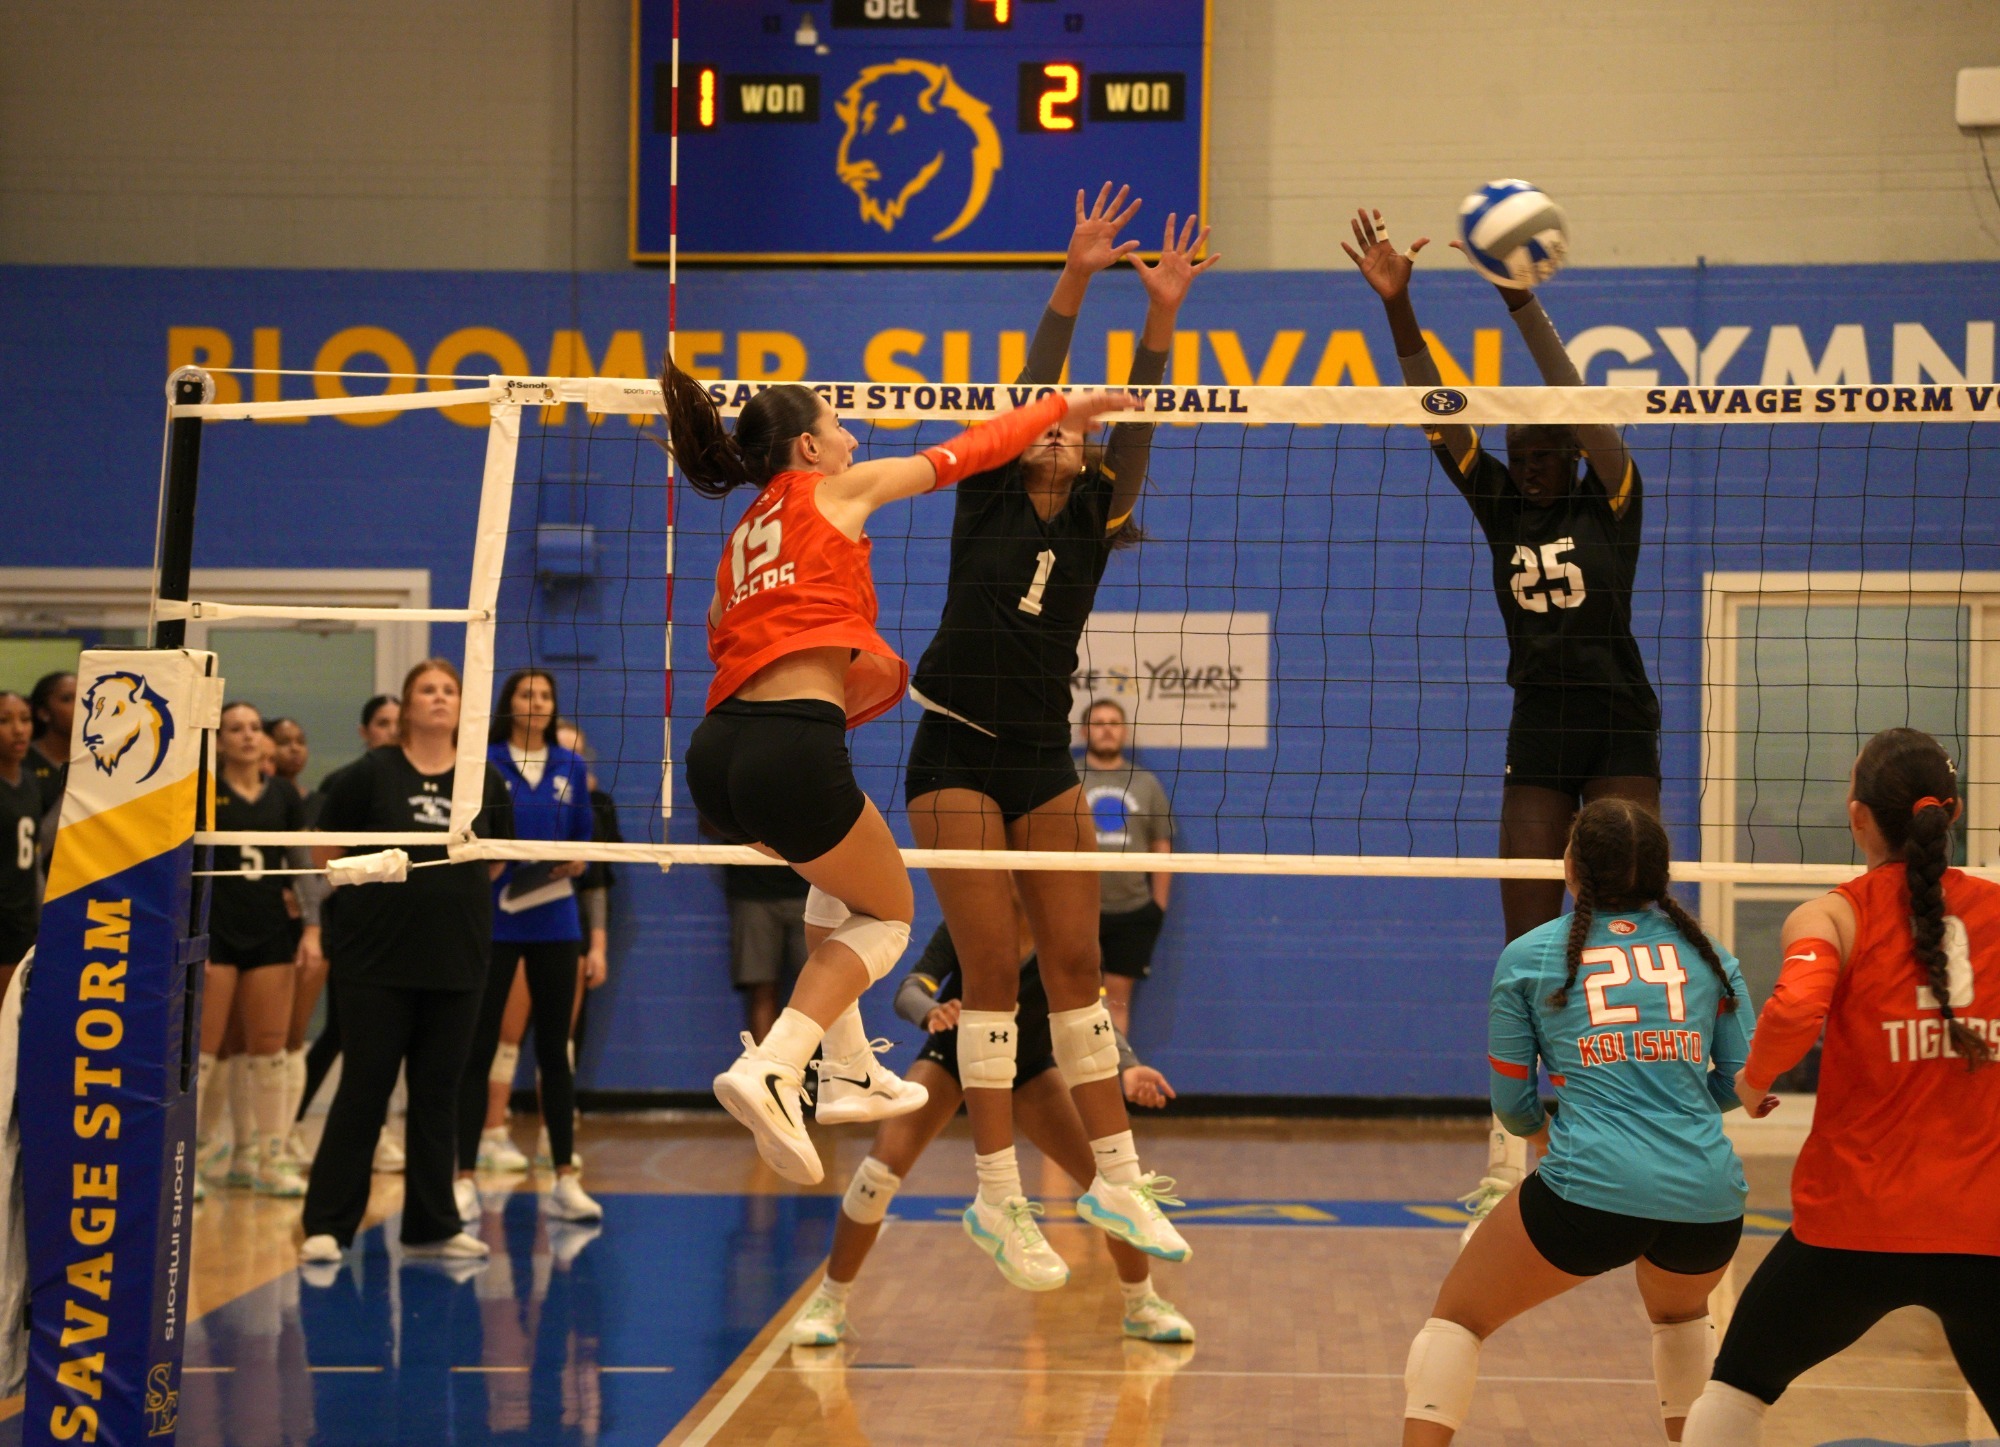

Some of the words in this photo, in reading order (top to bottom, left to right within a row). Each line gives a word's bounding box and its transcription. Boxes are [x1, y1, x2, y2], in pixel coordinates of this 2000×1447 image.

[698, 68, 715, 127] 1
[740, 82, 805, 113] won
[1038, 64, 1080, 130] 2
[1105, 81, 1171, 113] won
[516, 381, 548, 389] Senoh
[707, 384, 855, 409] SAGE
[867, 385, 995, 410] STORM
[1006, 386, 1249, 413] VYBALL
[1646, 388, 1802, 415] SAVAGE
[1815, 387, 1953, 413] STORM
[1965, 386, 2000, 412] V
[731, 496, 783, 592] 15
[1510, 536, 1587, 613] 25
[1017, 548, 1057, 616] 1
[17, 815, 36, 870] 6
[73, 897, 132, 1141] STORM
[1580, 943, 1689, 1028] 24
[1577, 1031, 1628, 1068] KOI
[1632, 1029, 1702, 1064] ISHTO
[172, 1140, 186, 1228] sports
[49, 1163, 120, 1444] SAVAGE
[165, 1232, 181, 1341] imports
